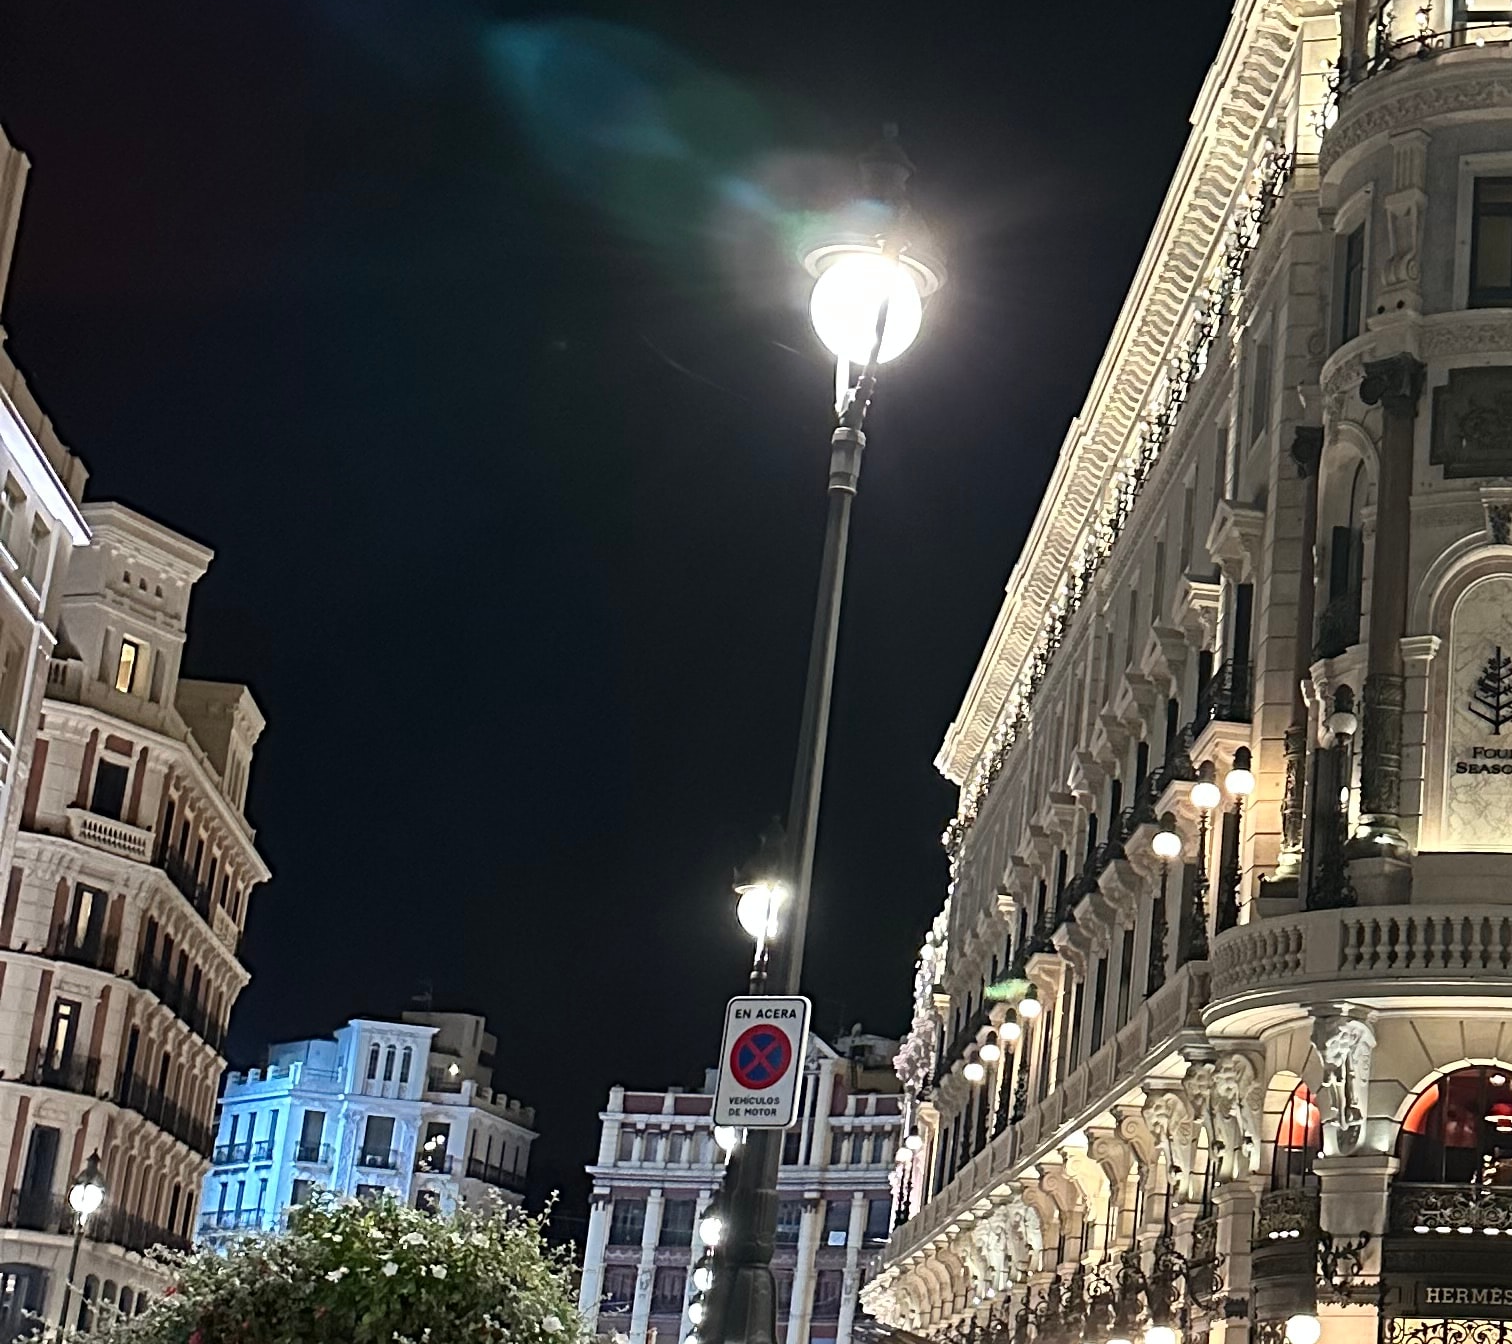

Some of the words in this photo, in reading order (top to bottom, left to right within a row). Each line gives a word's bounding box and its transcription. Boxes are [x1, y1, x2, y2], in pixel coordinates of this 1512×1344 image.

[735, 1008, 751, 1019] EN
[755, 1008, 797, 1019] ACERA
[729, 1095, 780, 1105] VEHÍCULOS
[728, 1108, 740, 1117] DE
[744, 1108, 777, 1117] MOTOR
